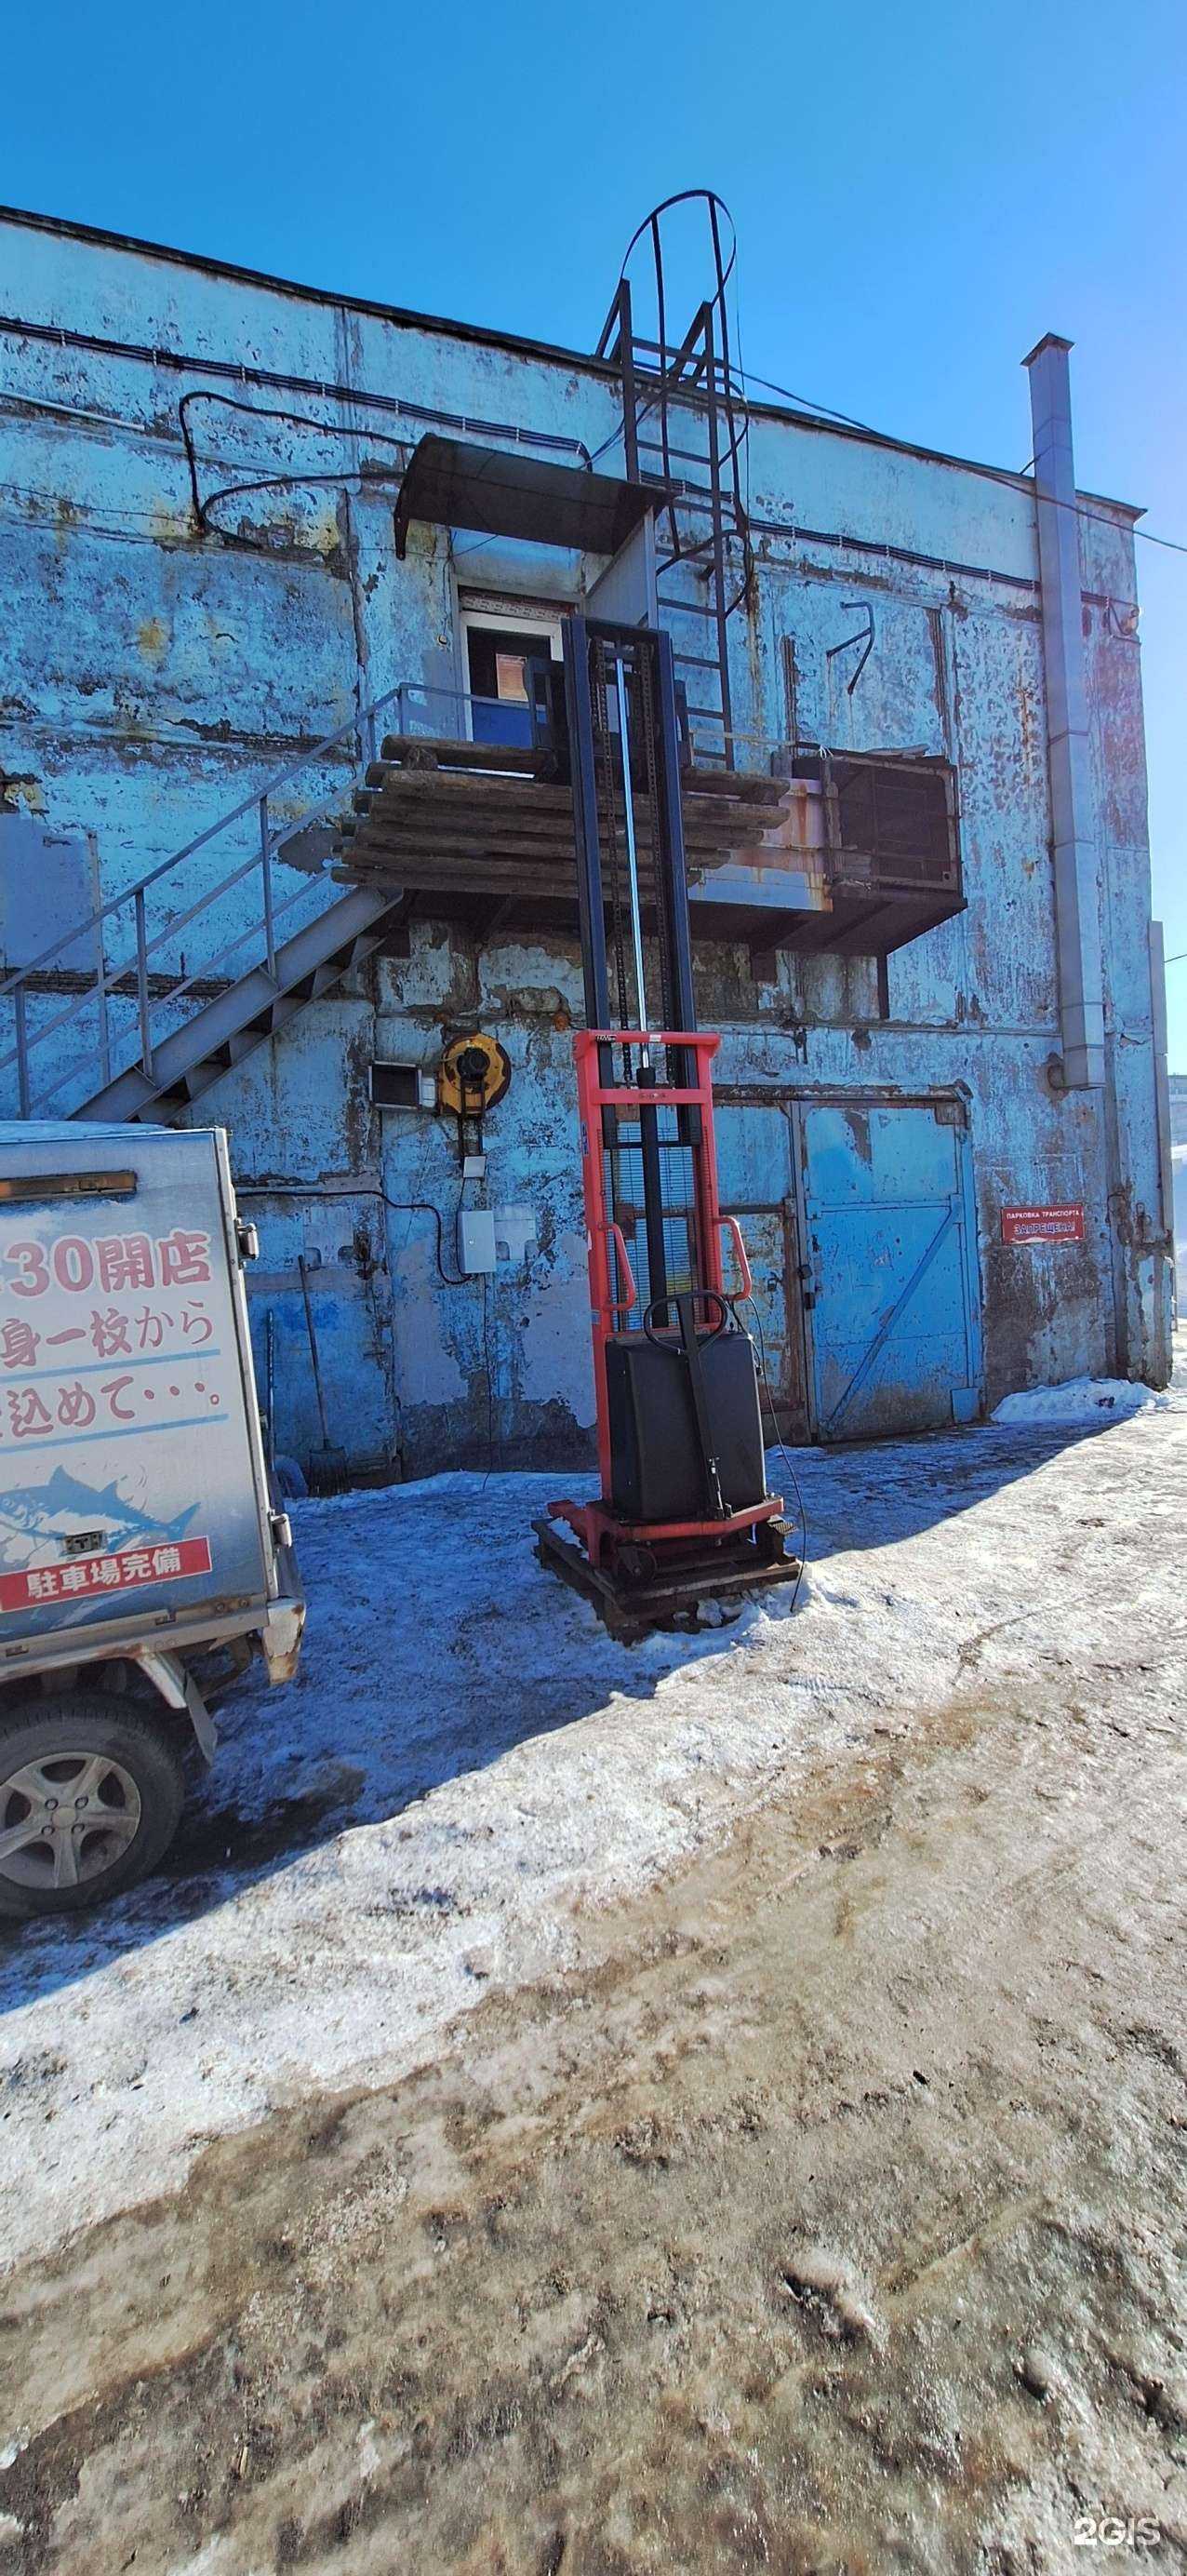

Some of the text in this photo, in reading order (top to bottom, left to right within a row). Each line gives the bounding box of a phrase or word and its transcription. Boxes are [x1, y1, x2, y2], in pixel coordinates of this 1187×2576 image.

[1, 1231, 211, 1296] 30開店
[26, 1547, 181, 1599] 駐車場完備
